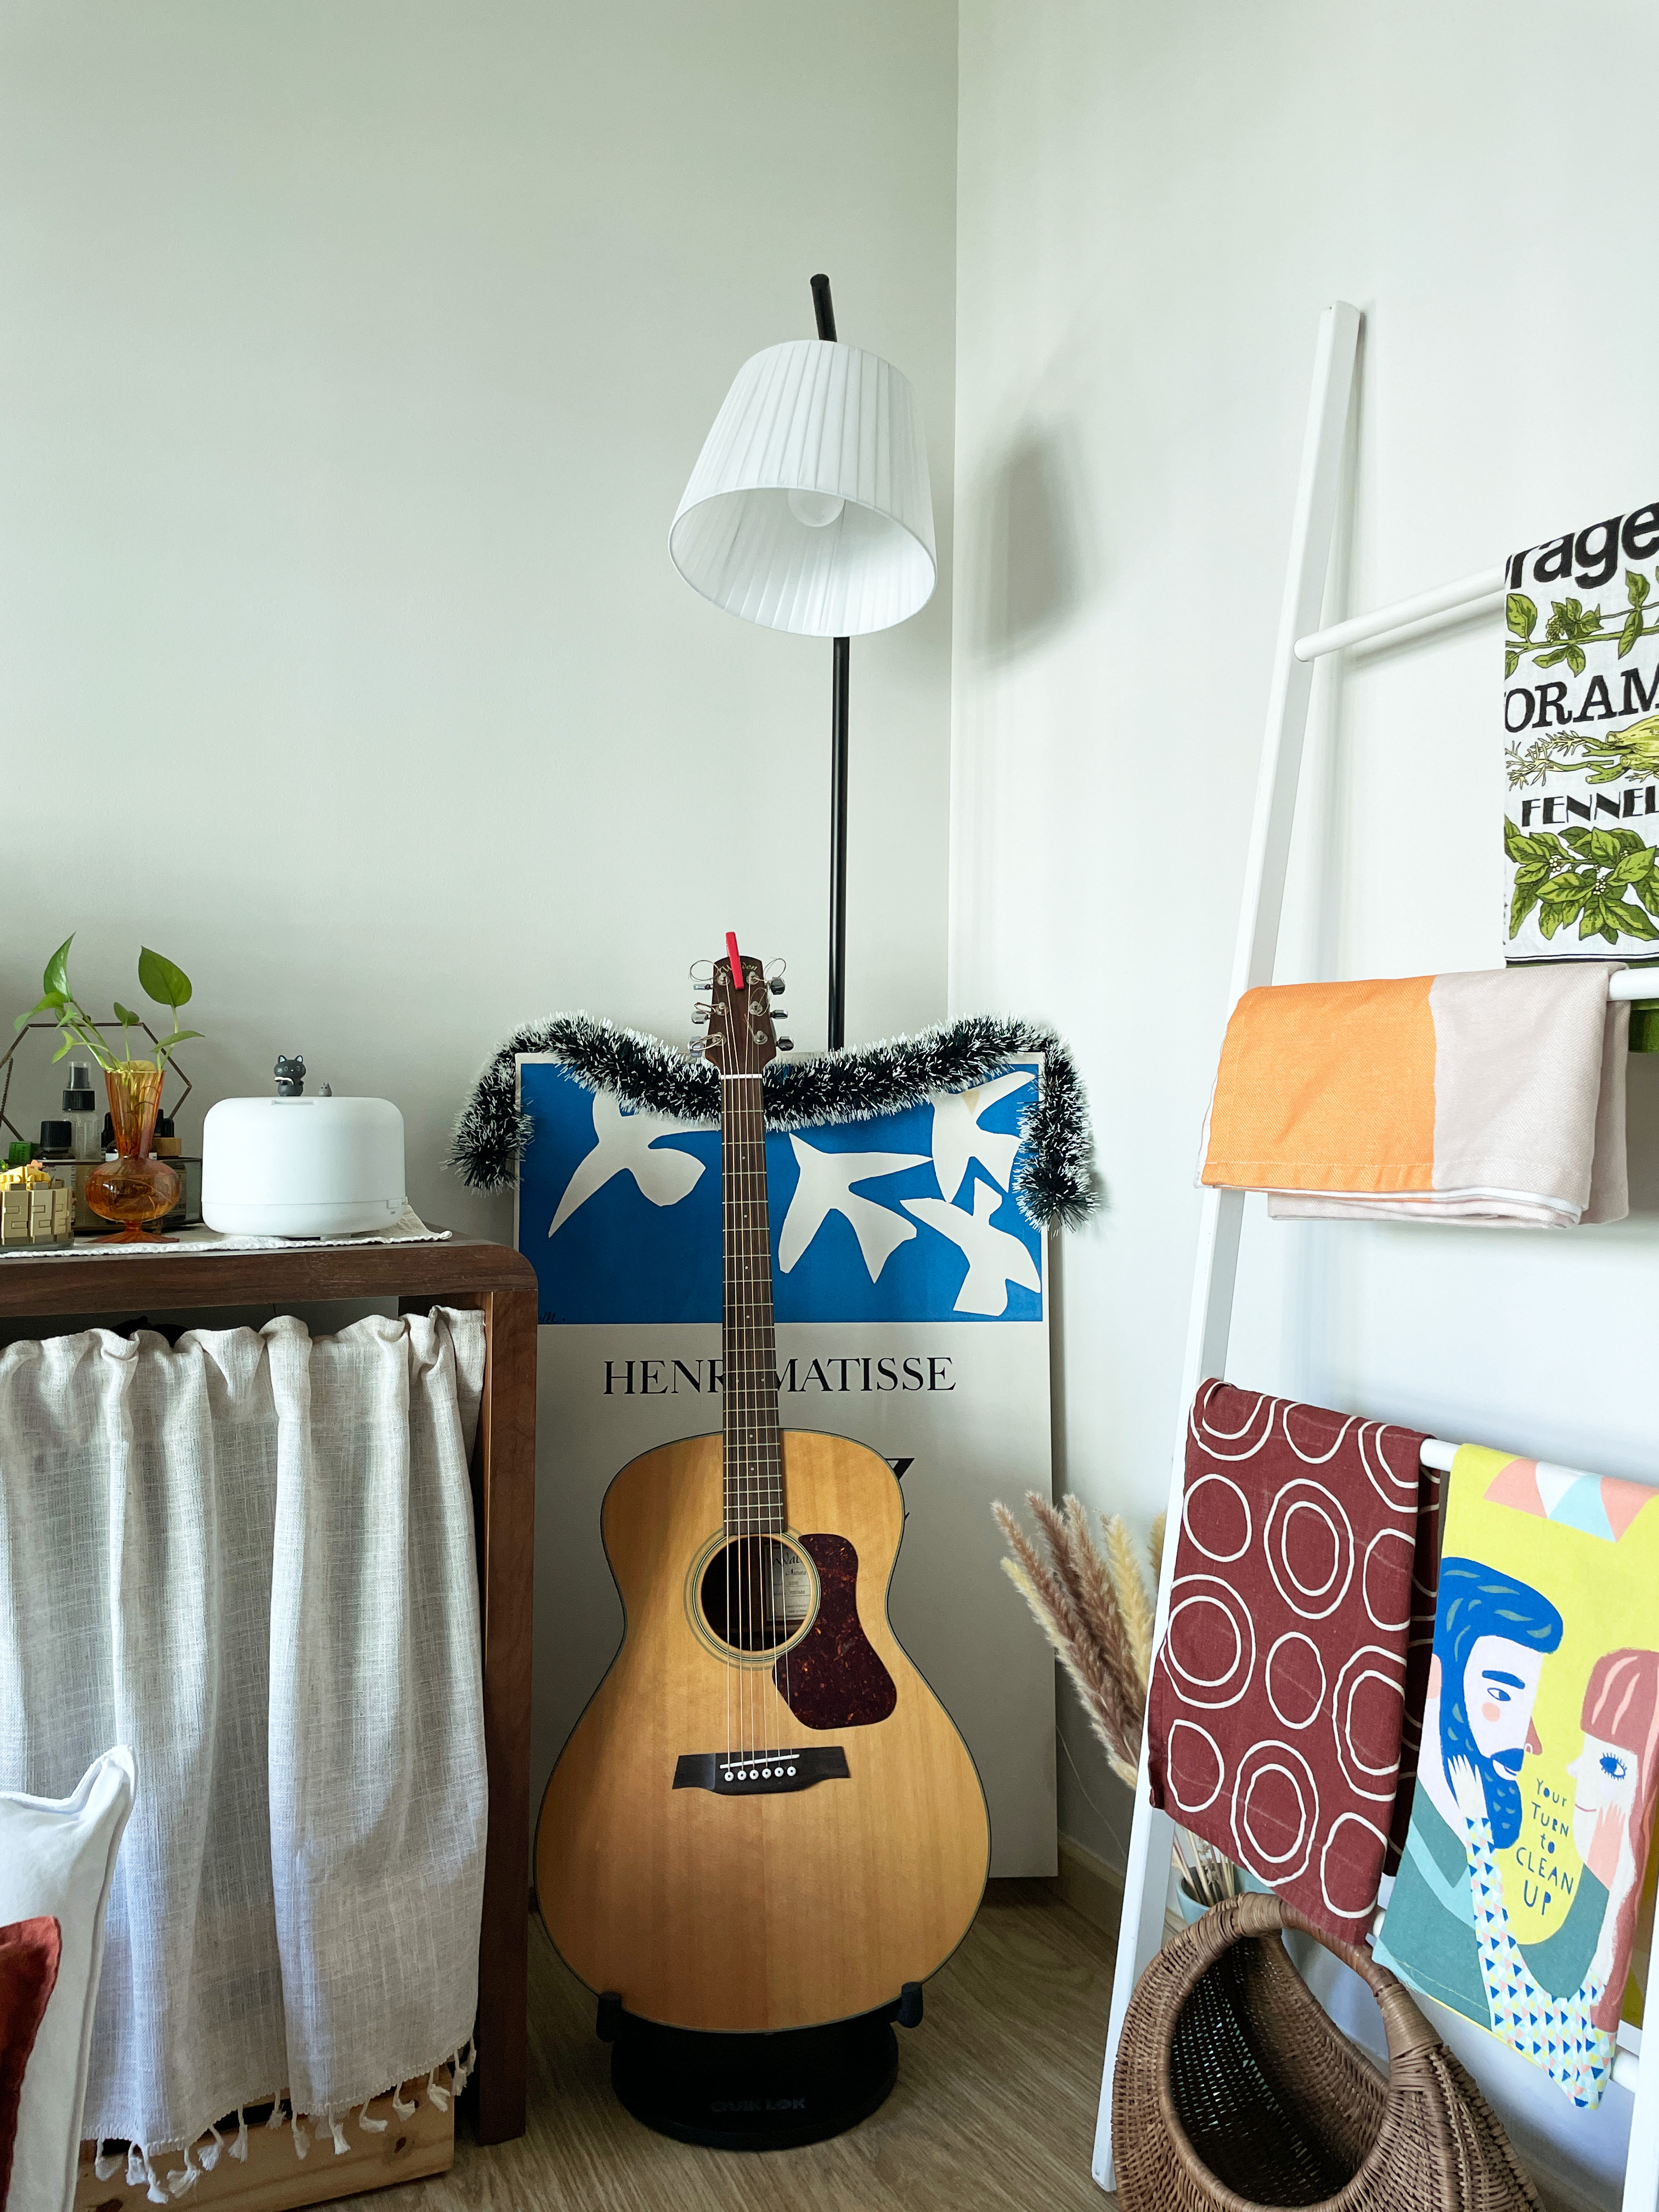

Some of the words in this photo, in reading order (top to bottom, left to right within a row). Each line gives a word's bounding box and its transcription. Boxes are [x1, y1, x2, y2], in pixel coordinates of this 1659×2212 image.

[1504, 501, 1659, 589] rage
[1521, 785, 1659, 827] FENNEL
[719, 961, 758, 972] Wden
[603, 1359, 724, 1395] HENR
[776, 1357, 956, 1392] MATISSE
[1531, 1802, 1569, 1838] TURN
[1516, 1847, 1574, 1895] CLEAN
[1523, 1880, 1551, 1916] UP
